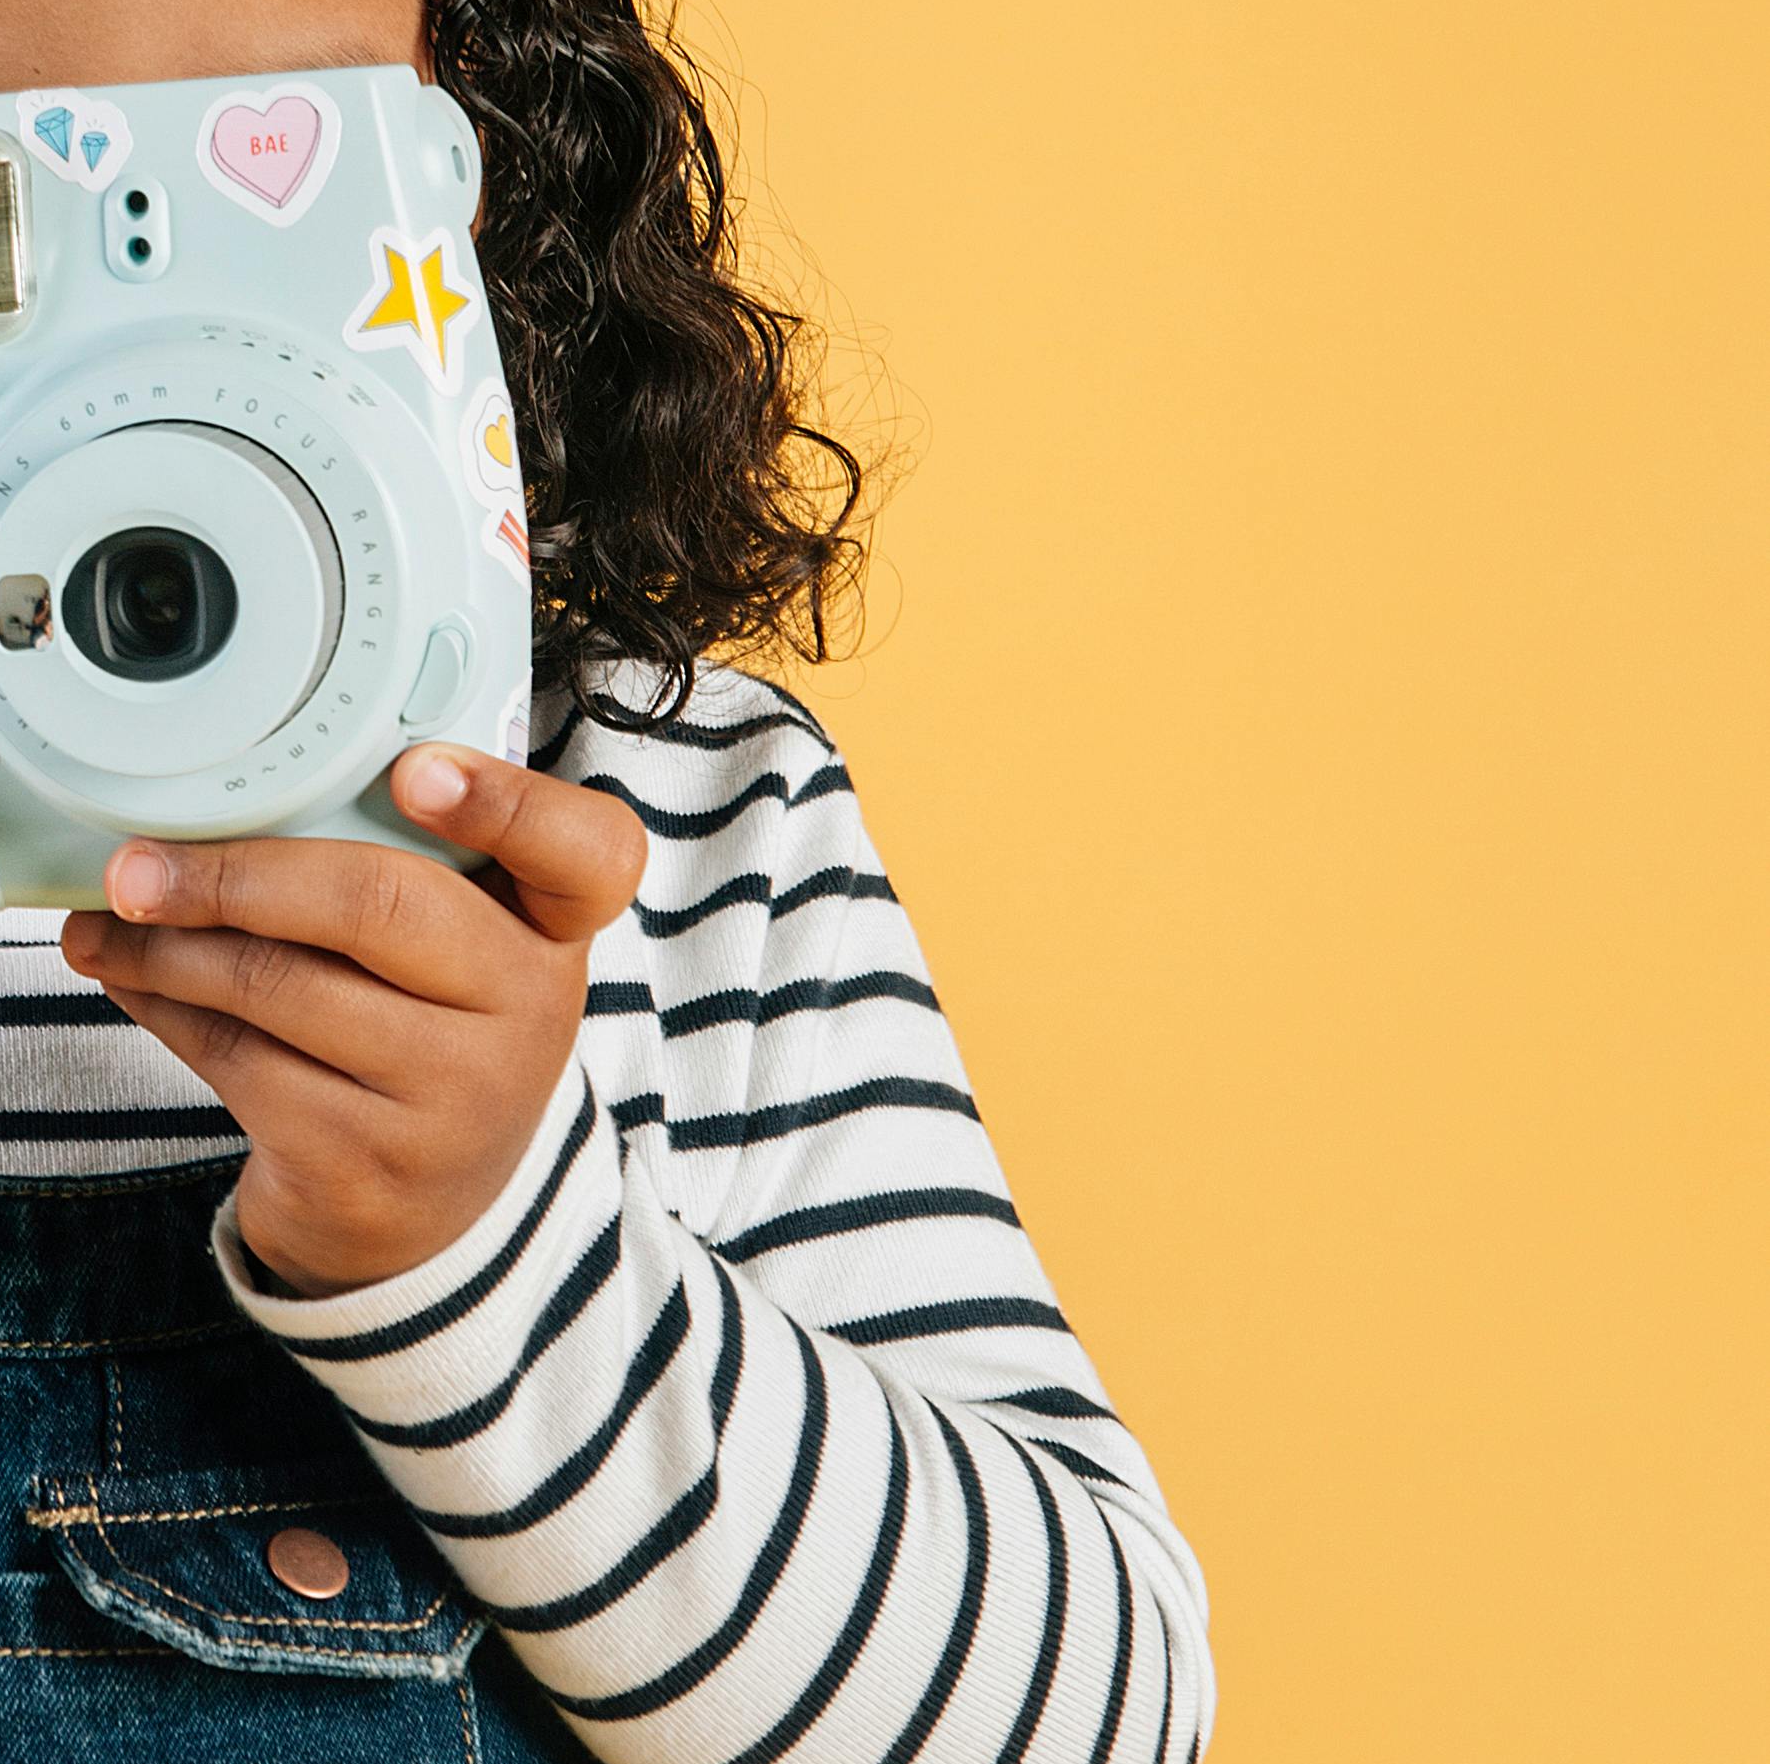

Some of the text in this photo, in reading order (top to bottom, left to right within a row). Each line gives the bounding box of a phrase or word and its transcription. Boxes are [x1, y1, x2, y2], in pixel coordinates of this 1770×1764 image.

[249, 134, 289, 156] BAE
[59, 385, 168, 433] 60mm
[215, 387, 338, 472] FOCUS
[352, 508, 383, 651] RANGE
